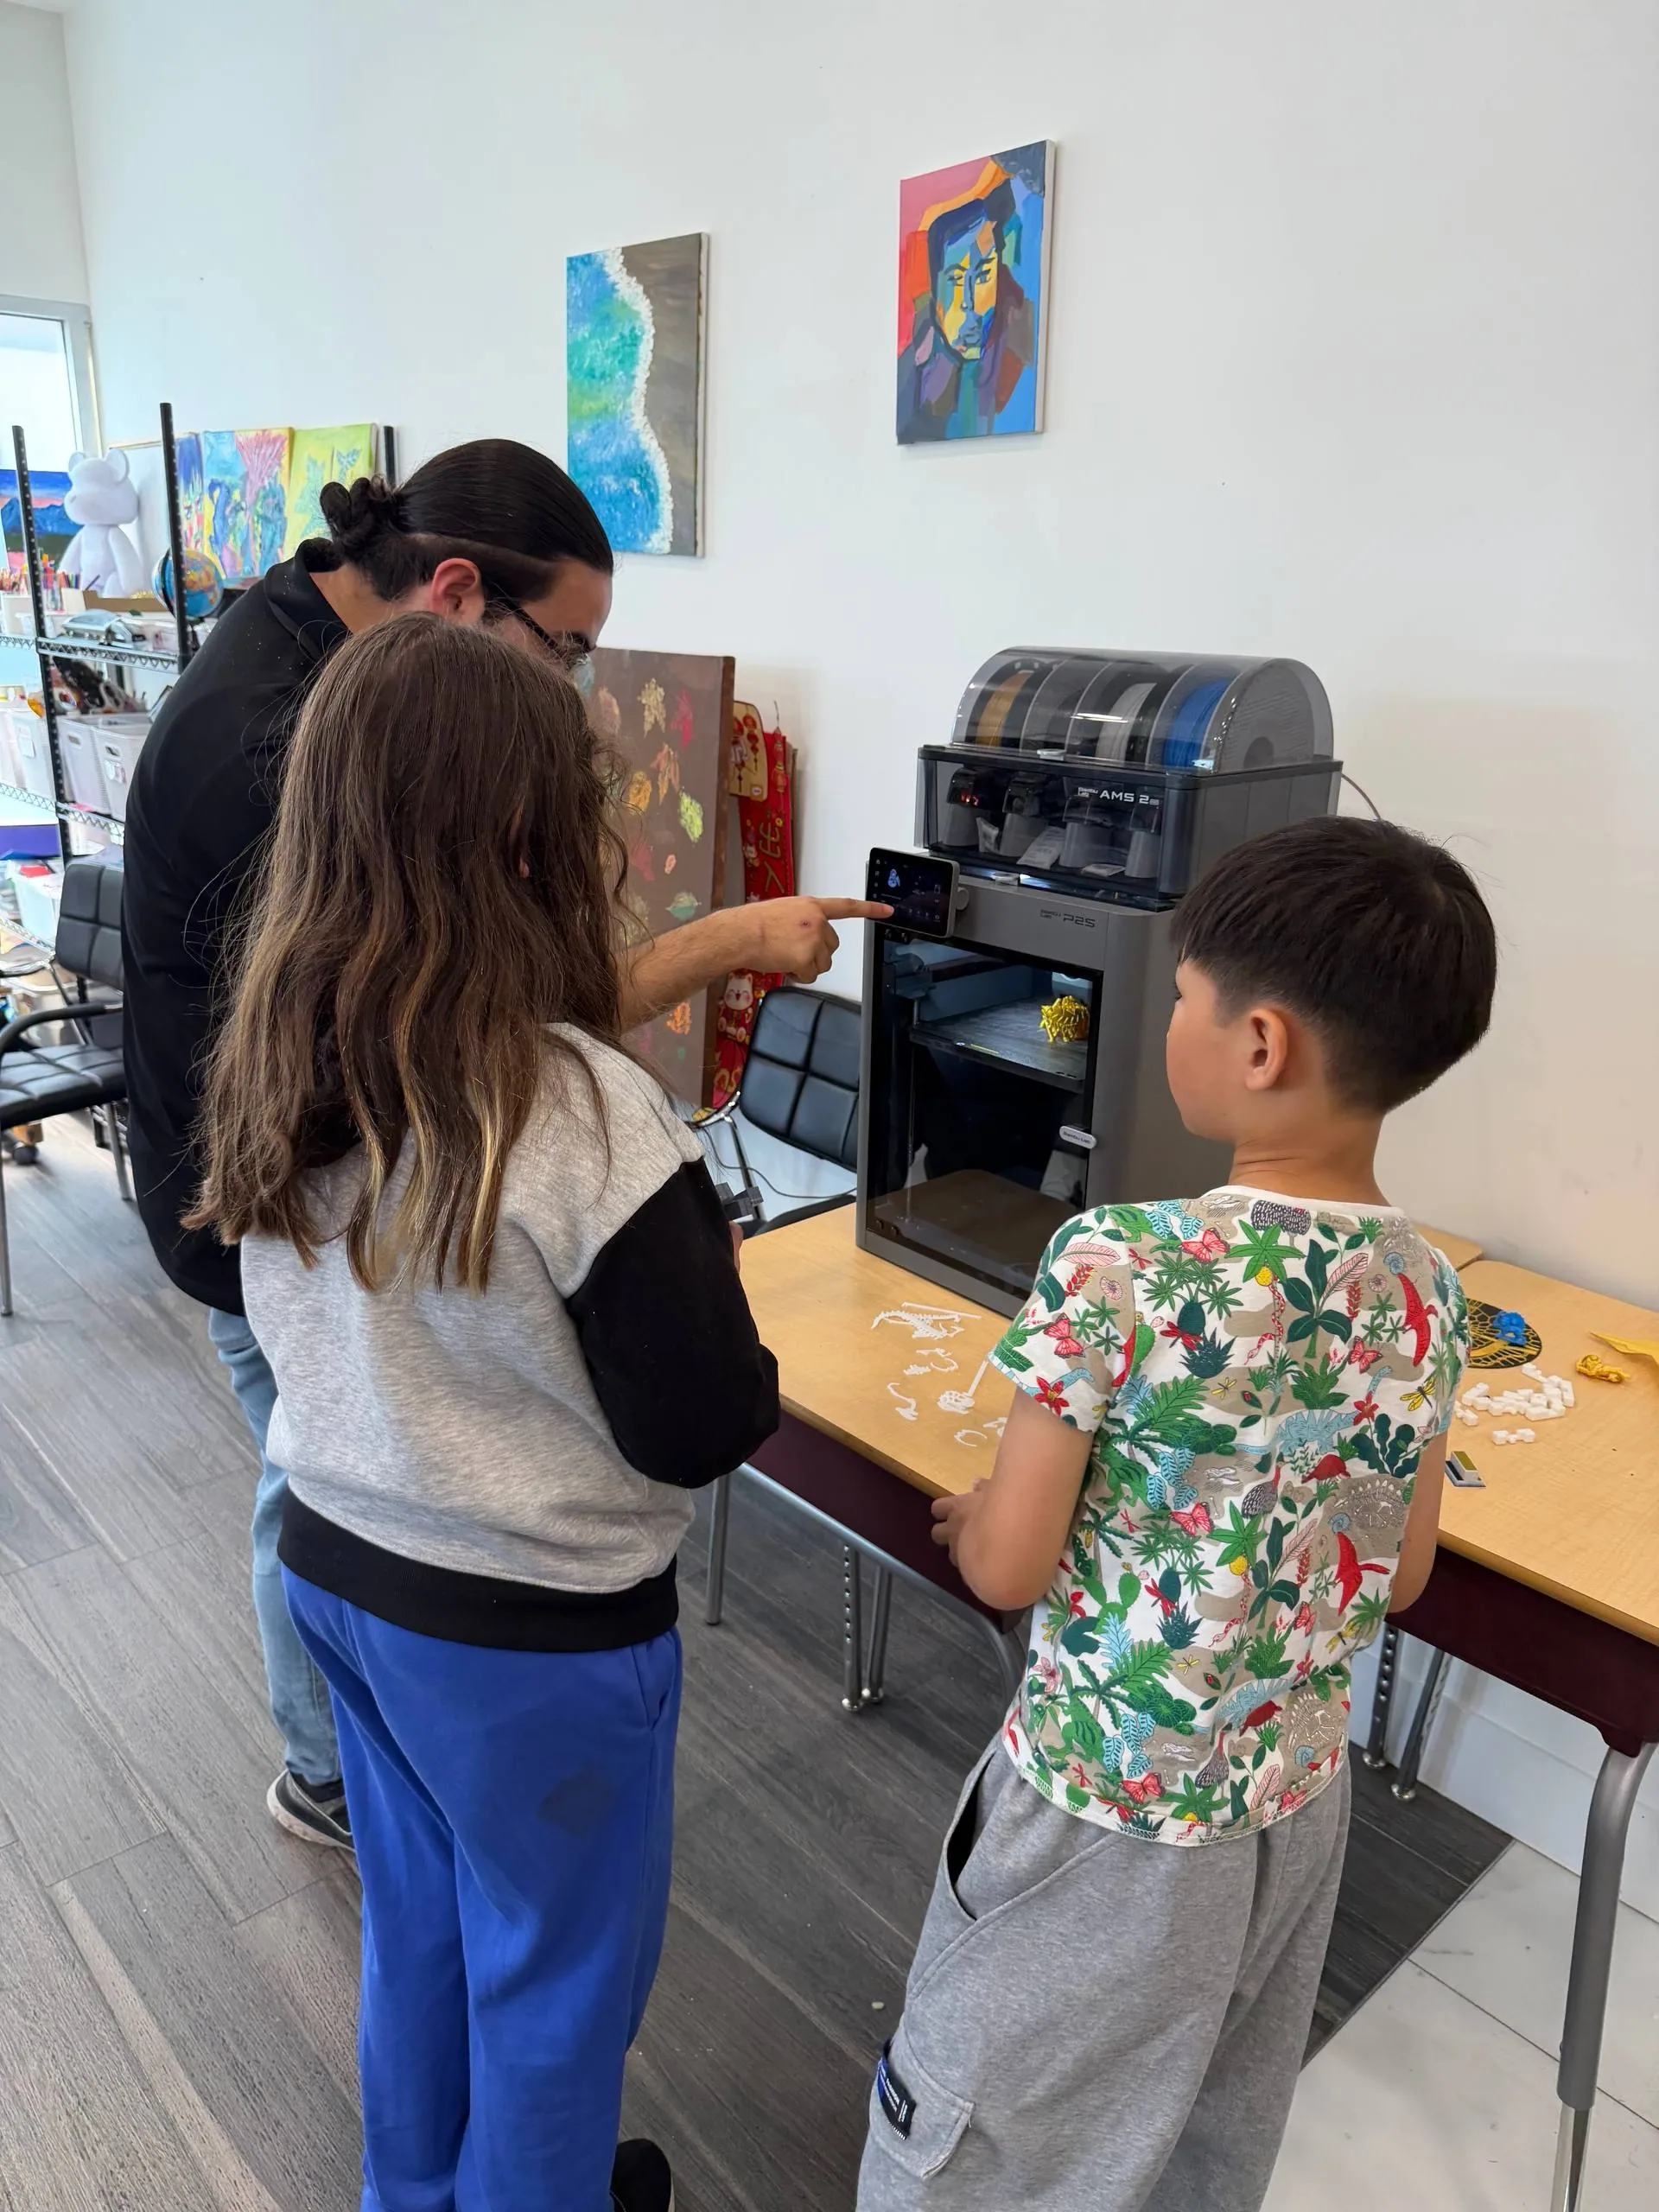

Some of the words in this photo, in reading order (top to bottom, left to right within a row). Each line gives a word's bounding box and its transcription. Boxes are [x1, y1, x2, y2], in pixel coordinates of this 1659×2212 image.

[1099, 790, 1135, 803] AMS
[1139, 794, 1149, 804] 2
[1063, 913, 1096, 928] P2S
